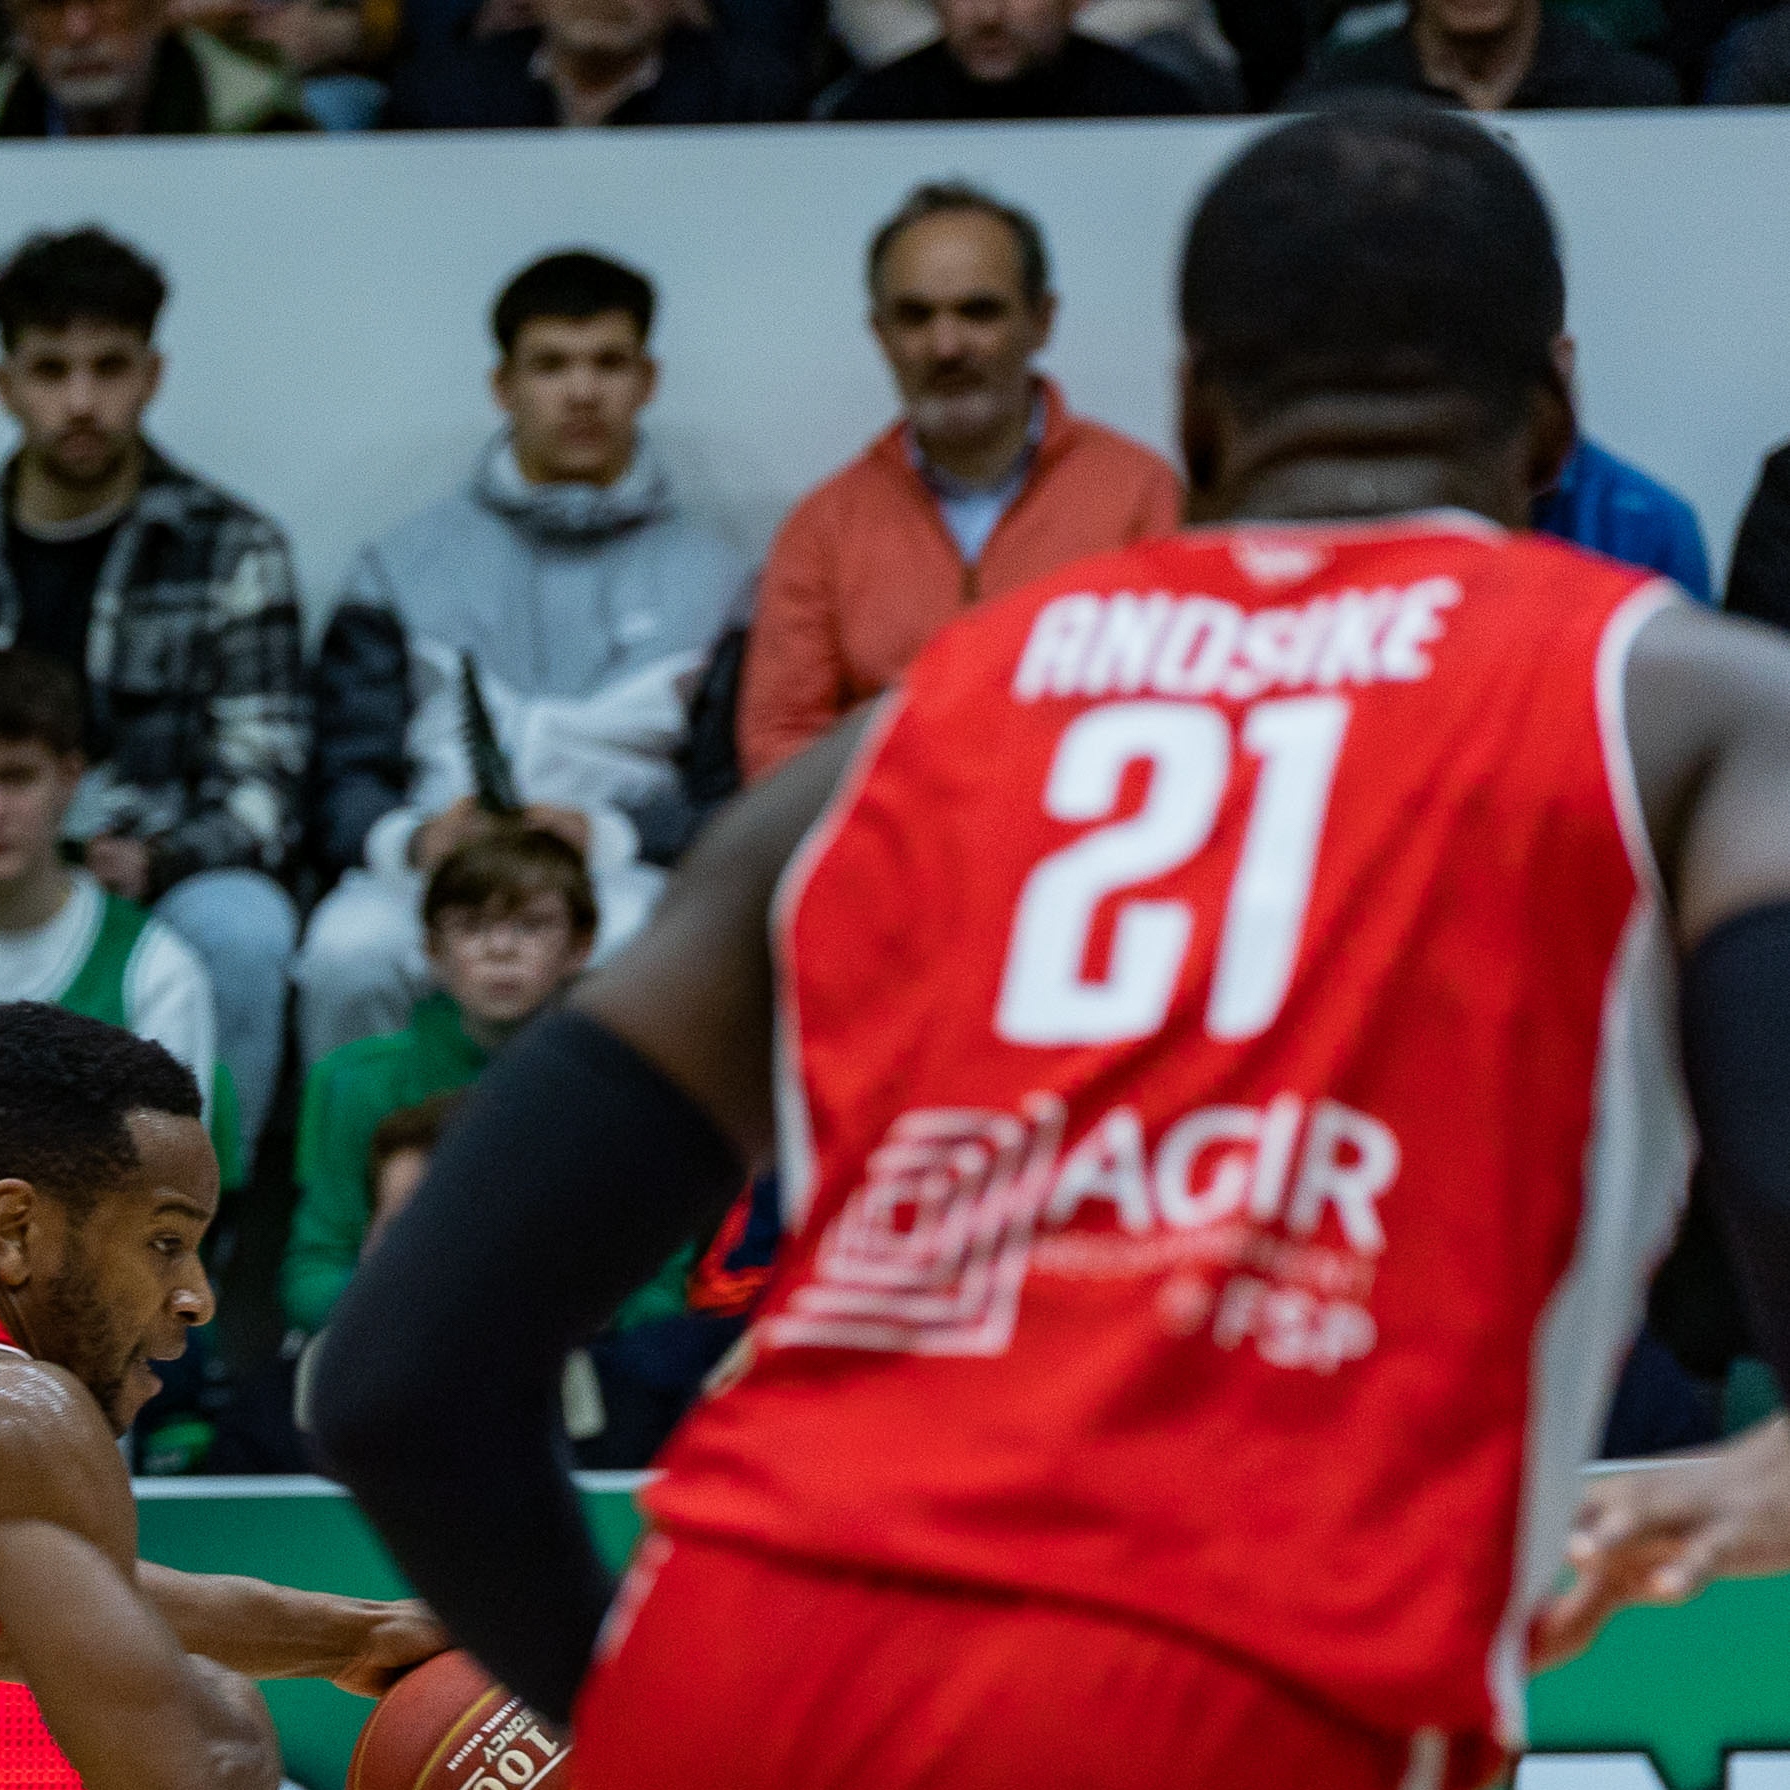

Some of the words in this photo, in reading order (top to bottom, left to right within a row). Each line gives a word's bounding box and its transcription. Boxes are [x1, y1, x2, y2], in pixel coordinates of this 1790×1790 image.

[994, 693, 1353, 1047] 21
[1042, 1092, 1400, 1253] AGIR
[481, 1705, 533, 1764] EGACY
